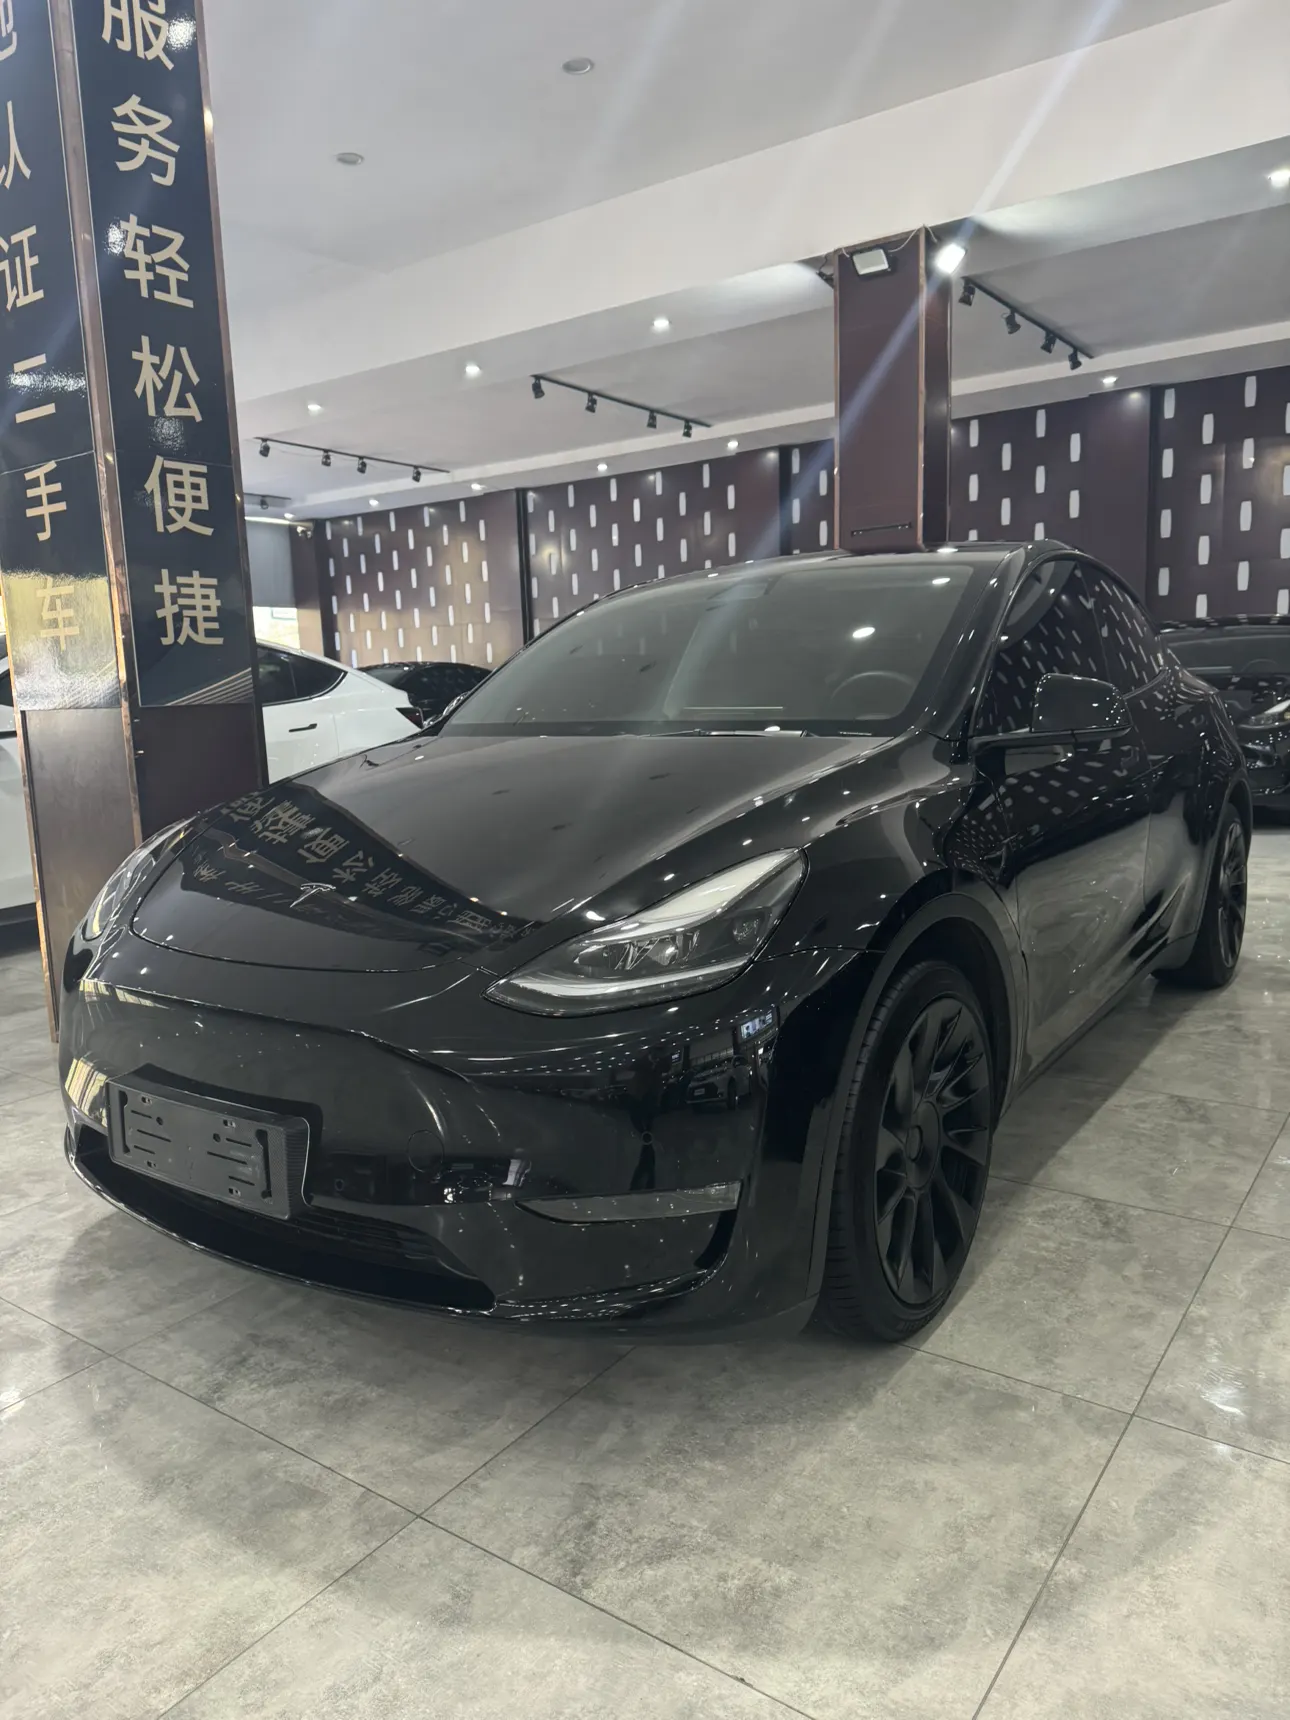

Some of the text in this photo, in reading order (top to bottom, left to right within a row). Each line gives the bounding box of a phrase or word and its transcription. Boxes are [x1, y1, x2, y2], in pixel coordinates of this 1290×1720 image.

[102, 0, 224, 646] 服务轻松便捷
